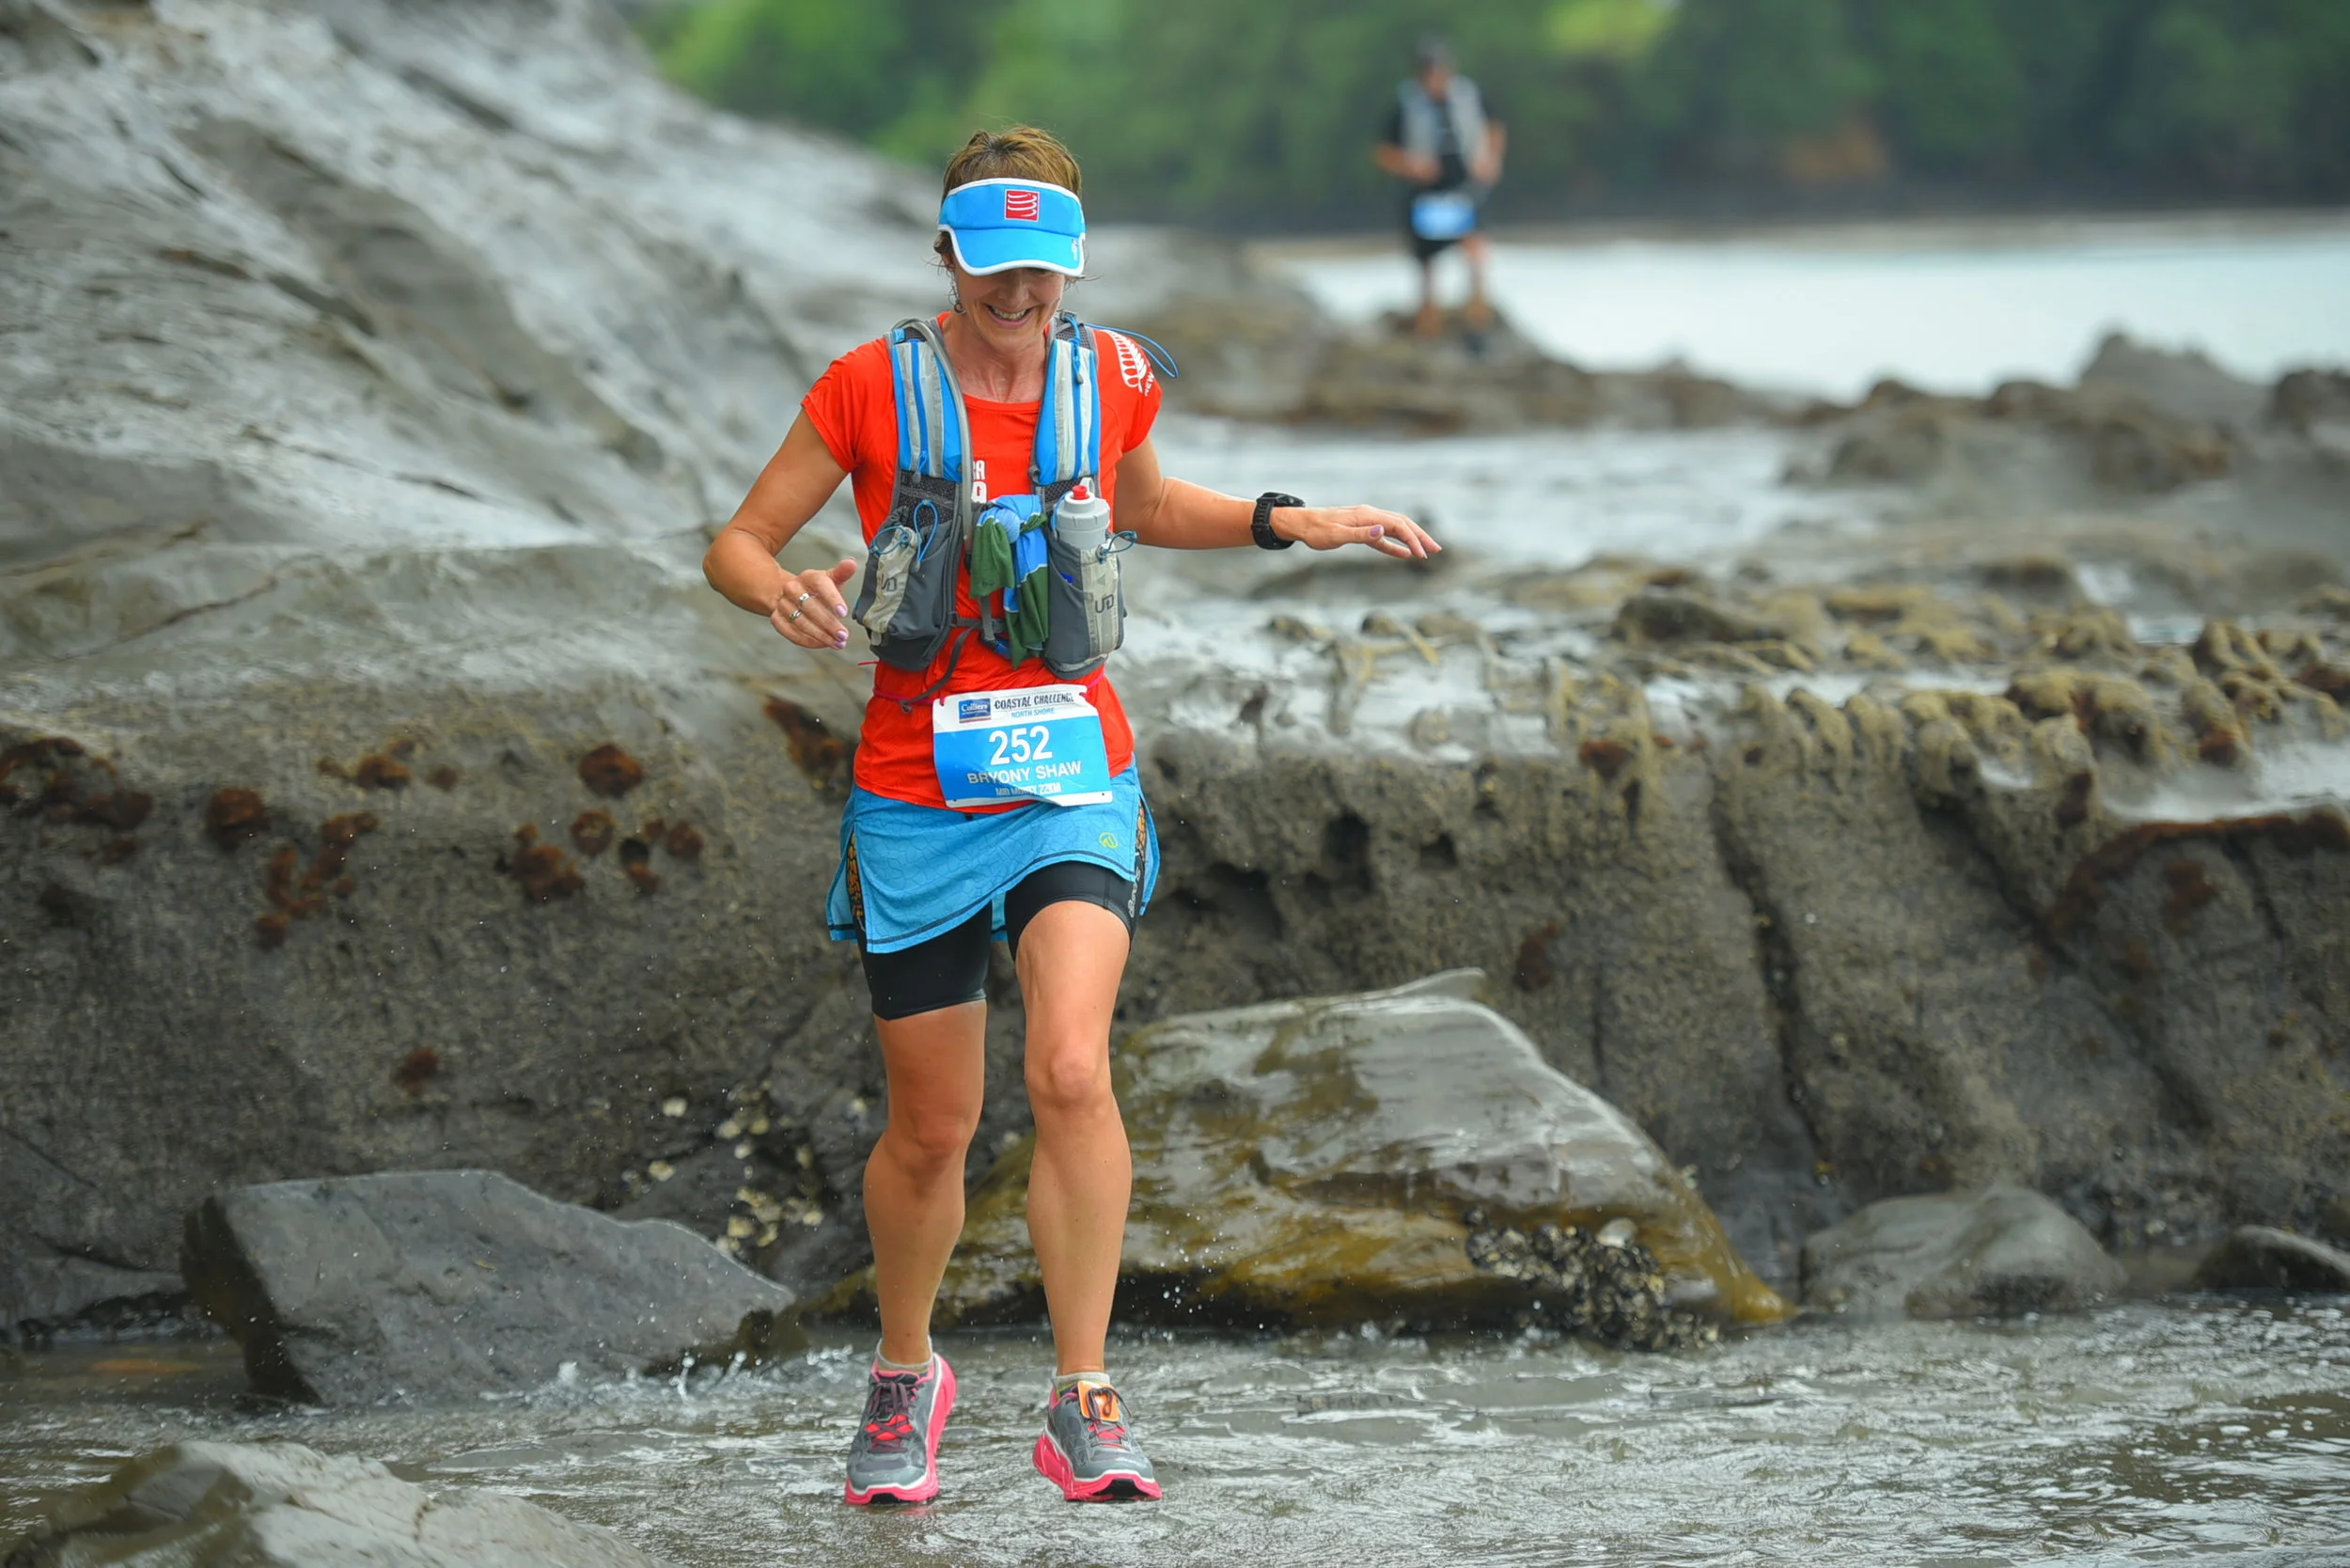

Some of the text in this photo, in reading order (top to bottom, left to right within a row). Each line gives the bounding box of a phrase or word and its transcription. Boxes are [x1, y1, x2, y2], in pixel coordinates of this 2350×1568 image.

[961, 702, 988, 713] Colliers
[995, 696, 1032, 710] COASTAL
[1011, 707, 1055, 719] NORTH SHORE
[989, 725, 1054, 766] 252
[966, 760, 1082, 784] BRYONY SHAW
